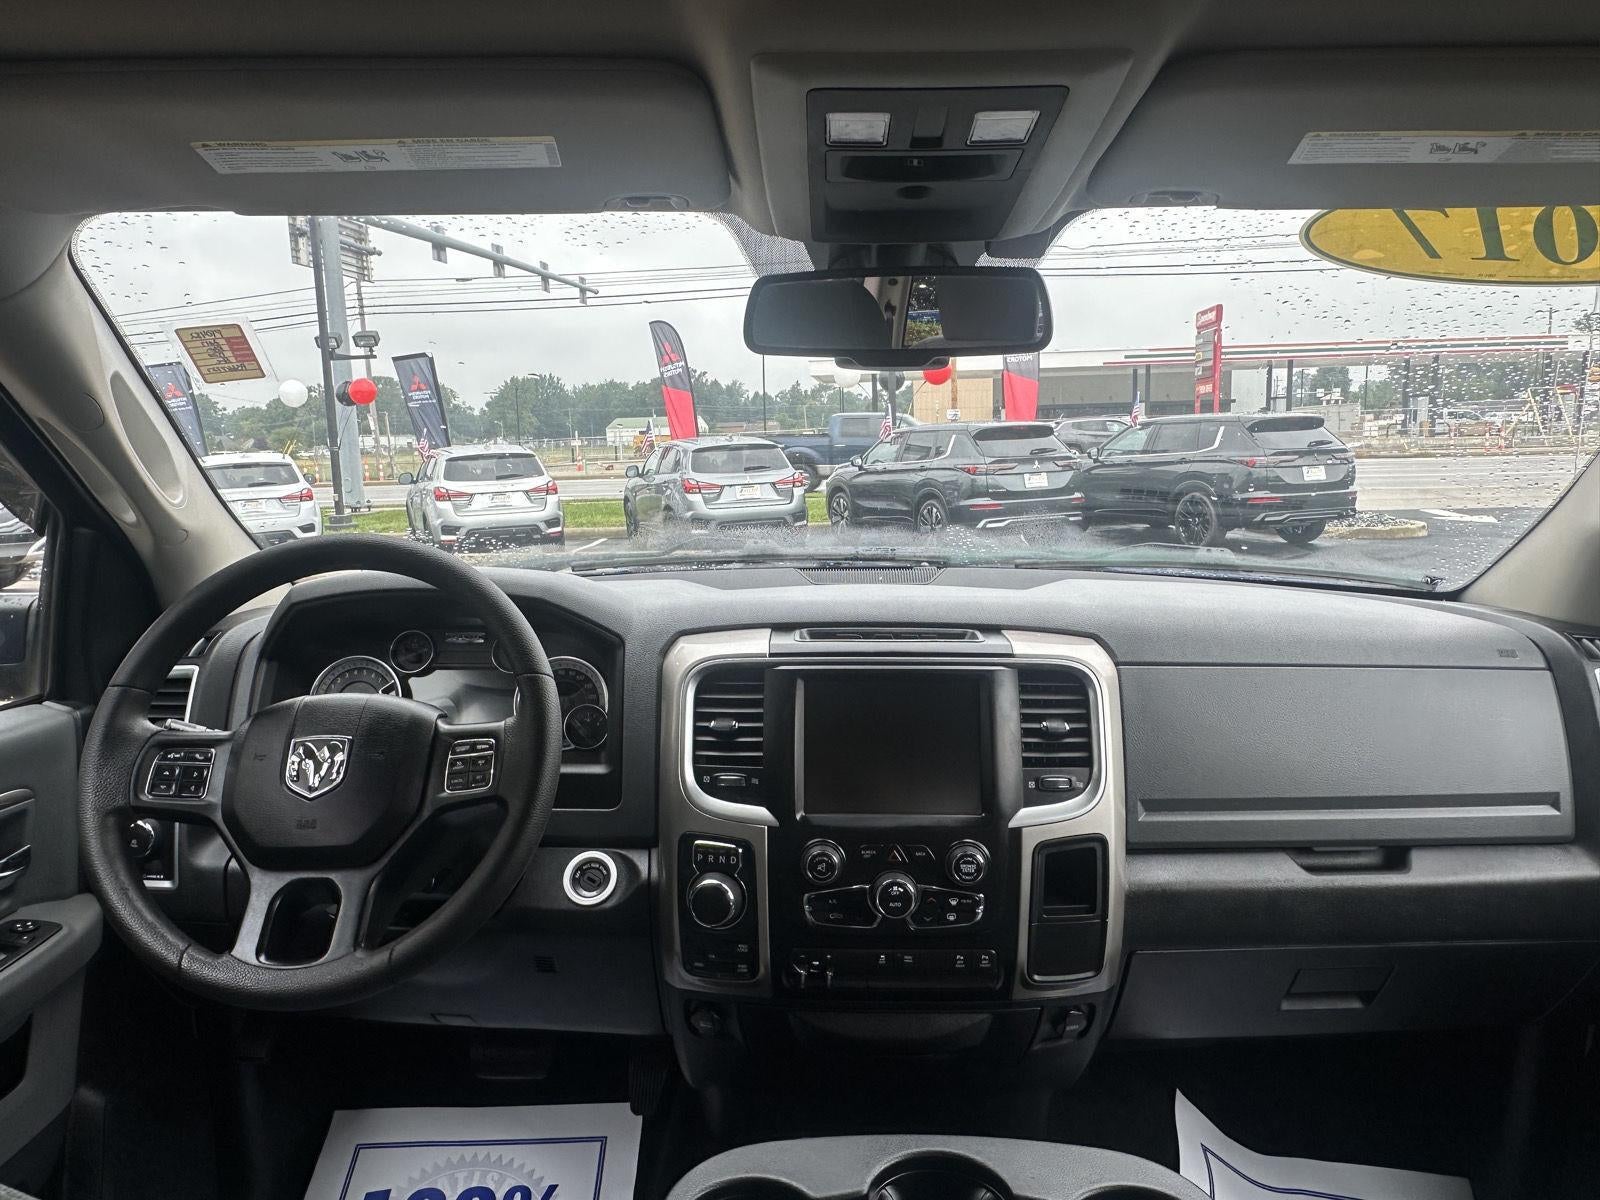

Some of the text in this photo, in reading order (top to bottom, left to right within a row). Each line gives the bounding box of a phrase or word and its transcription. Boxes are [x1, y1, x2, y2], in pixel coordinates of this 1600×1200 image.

[697, 853, 737, 864] P R N D
